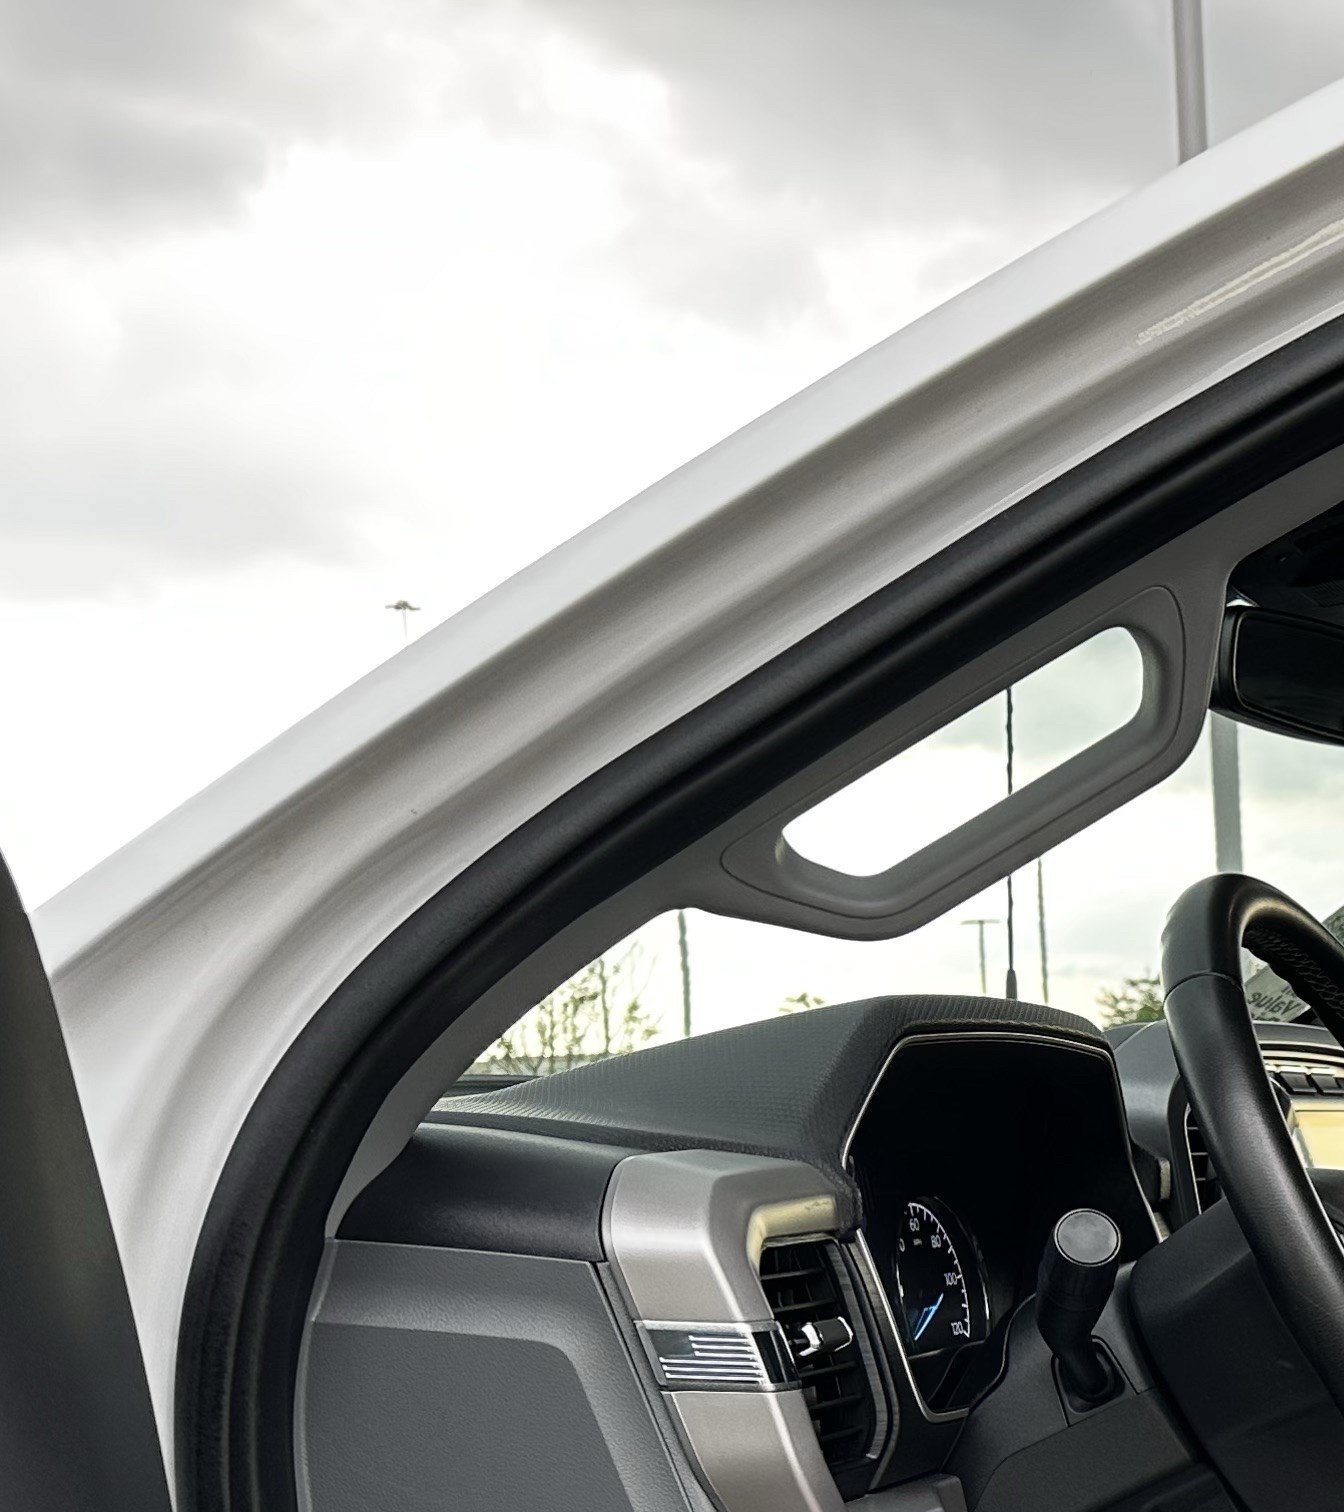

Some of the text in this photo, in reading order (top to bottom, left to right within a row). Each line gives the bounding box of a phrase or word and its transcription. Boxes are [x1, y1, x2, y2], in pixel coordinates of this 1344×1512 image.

[909, 1218, 920, 1232] 60
[930, 1234, 942, 1249] 80
[943, 1272, 958, 1287] 100
